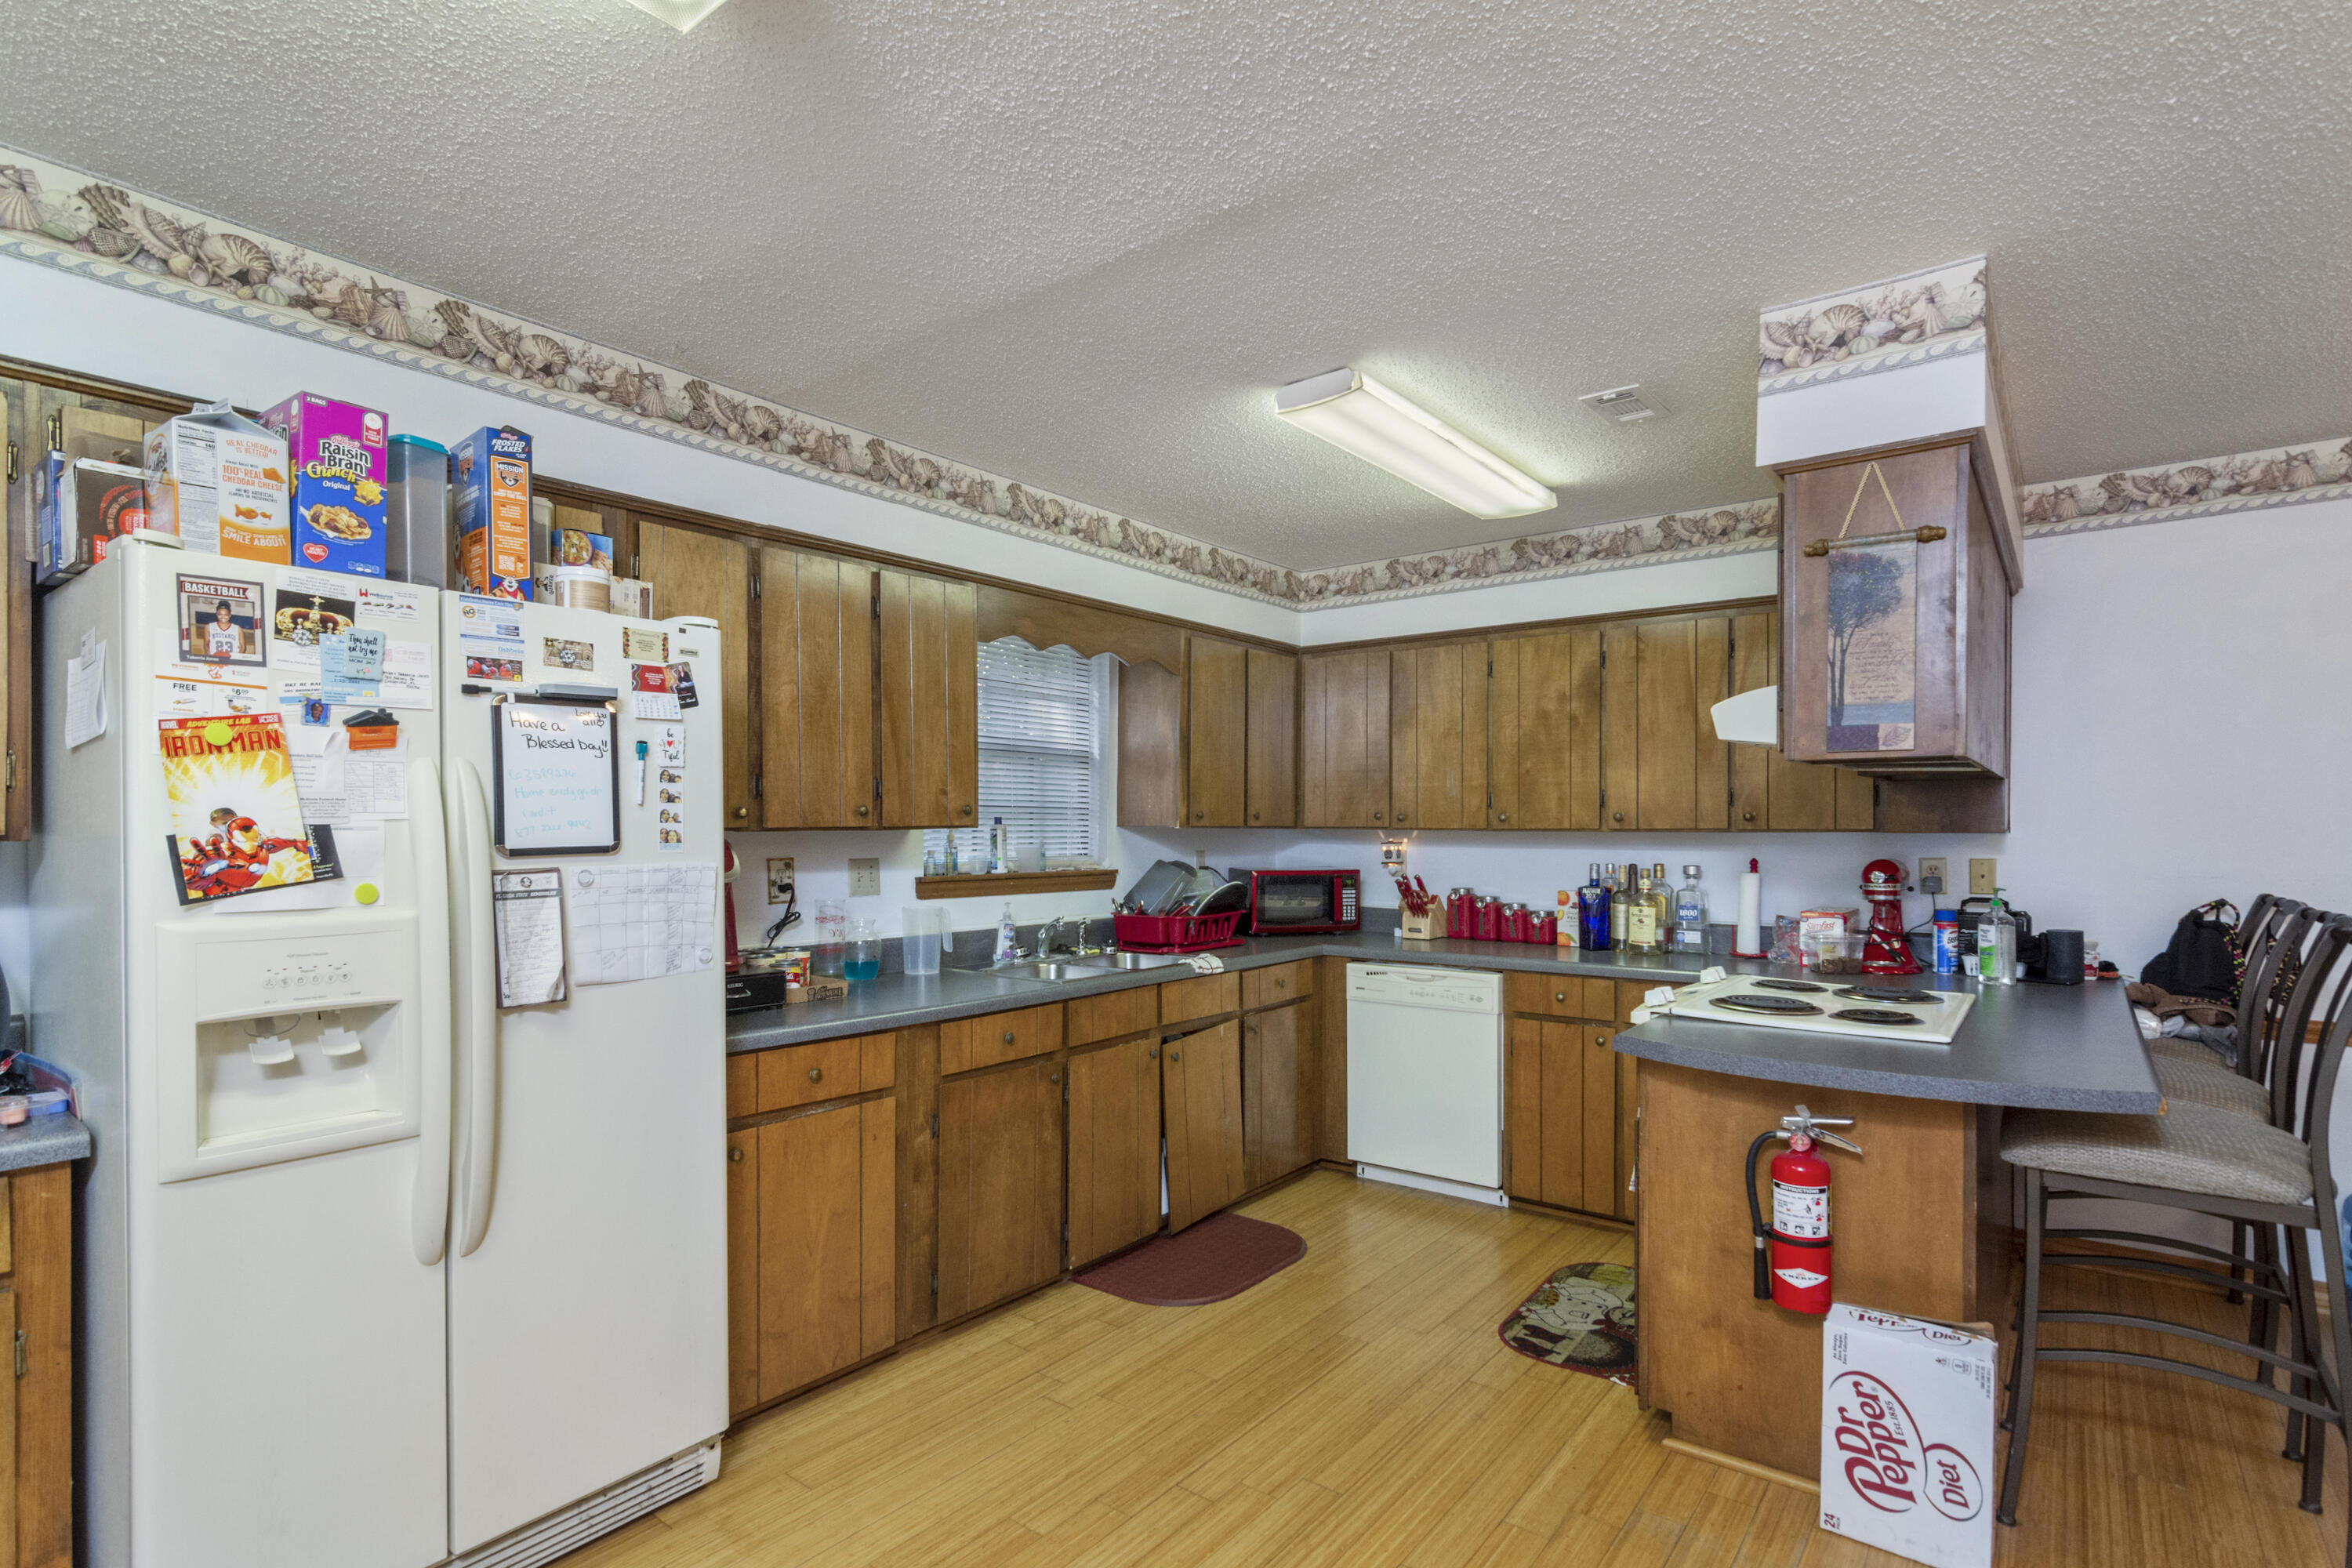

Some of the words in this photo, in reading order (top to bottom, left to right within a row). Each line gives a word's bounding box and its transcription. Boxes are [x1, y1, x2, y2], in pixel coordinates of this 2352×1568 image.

[246, 441, 278, 456] CHEDDAR
[321, 441, 369, 466] Raisin
[306, 462, 356, 482] Crunch
[327, 456, 365, 476] Bran
[496, 463, 524, 473] MISSION
[222, 474, 256, 486] CHEDDAR
[257, 480, 283, 492] CHEESE
[245, 470, 263, 481] REAL
[322, 480, 350, 491] Original
[221, 529, 252, 544] SMILE
[184, 583, 245, 597] BASKETBALL
[216, 641, 233, 652] 23
[350, 633, 363, 645] Thou
[359, 646, 368, 656] try
[172, 683, 197, 691] FREE
[509, 710, 547, 731] Have
[551, 723, 565, 731] a
[227, 729, 281, 754] MAN
[521, 733, 575, 750] Blessed
[1780, 1184, 1820, 1194] INSTRUCTIONS
[1782, 1272, 1820, 1281] AMEREX
[1834, 1406, 1876, 1460] Dr
[1845, 1381, 1918, 1506] Pepper
[1936, 1459, 1970, 1510] Diet
[1824, 1512, 1836, 1529] 24
